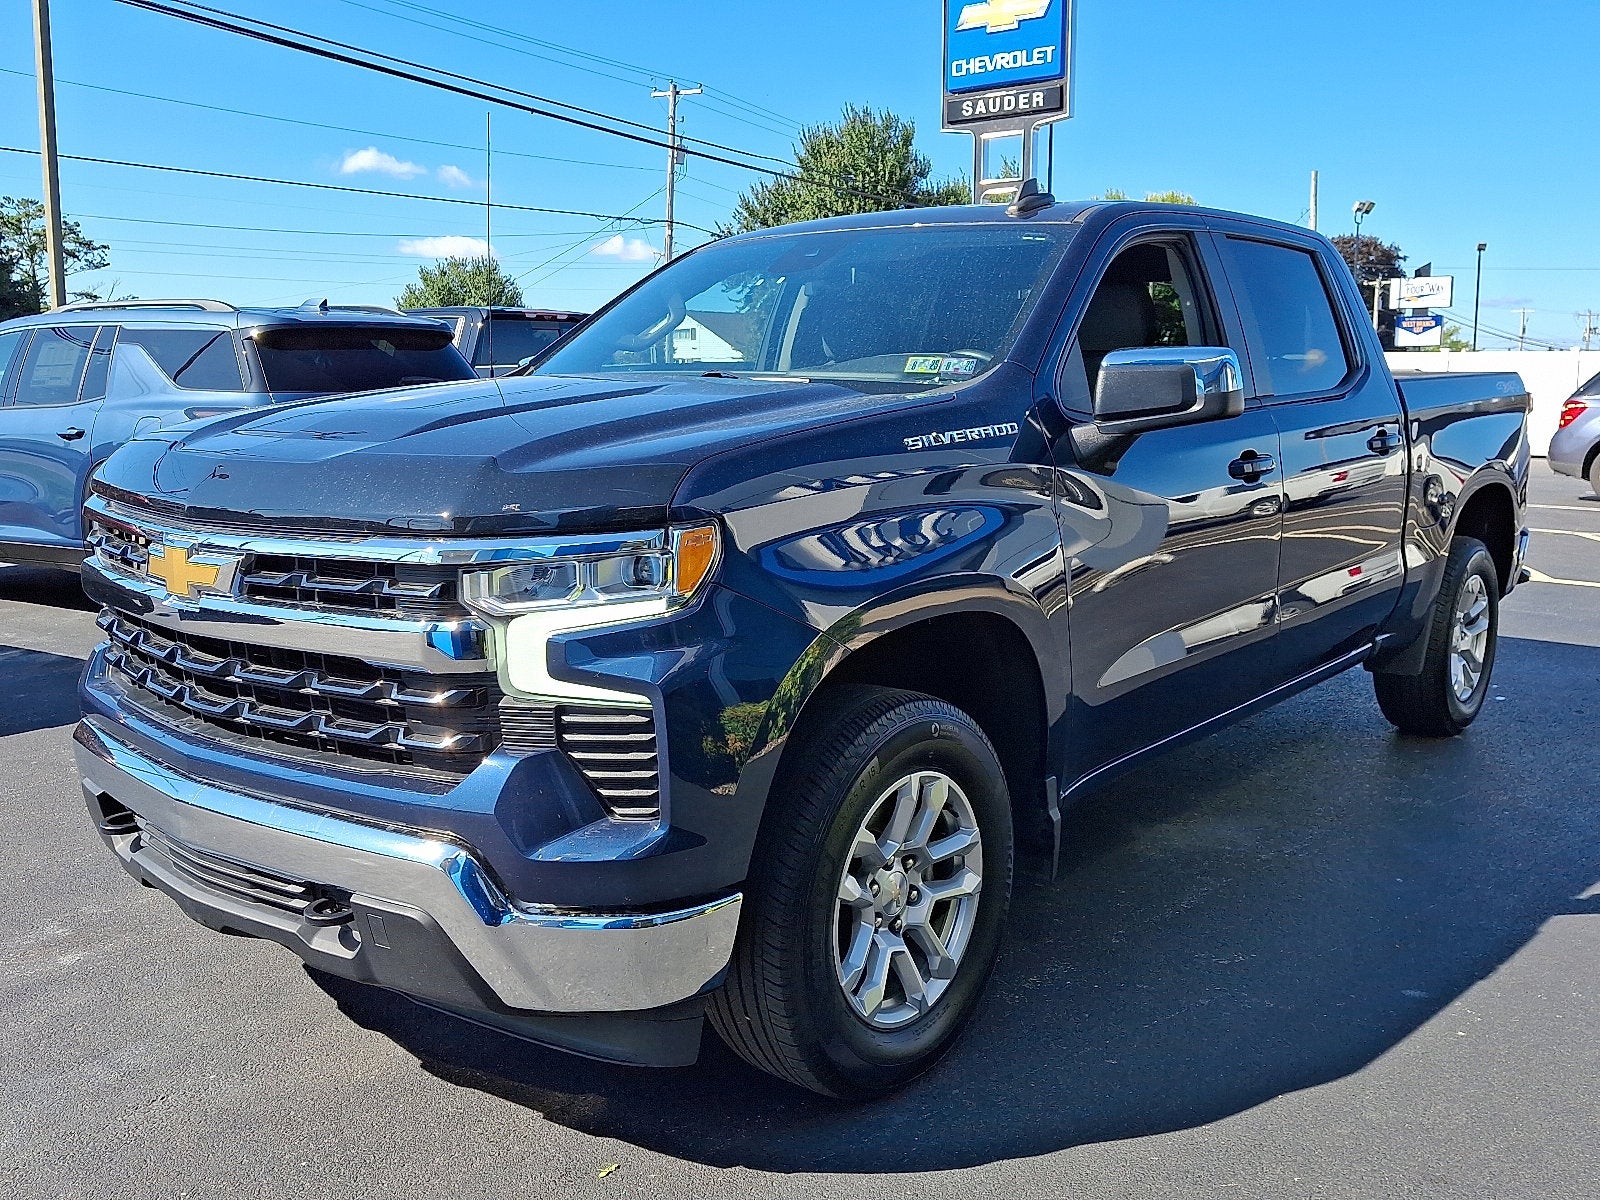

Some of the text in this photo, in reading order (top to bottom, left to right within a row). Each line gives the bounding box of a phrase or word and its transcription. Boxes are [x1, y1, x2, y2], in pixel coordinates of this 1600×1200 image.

[951, 45, 1056, 77] CHEVROLET
[961, 91, 1045, 117] SAUDER
[1426, 282, 1444, 295] WAY
[903, 422, 1019, 451] SILVERADO
